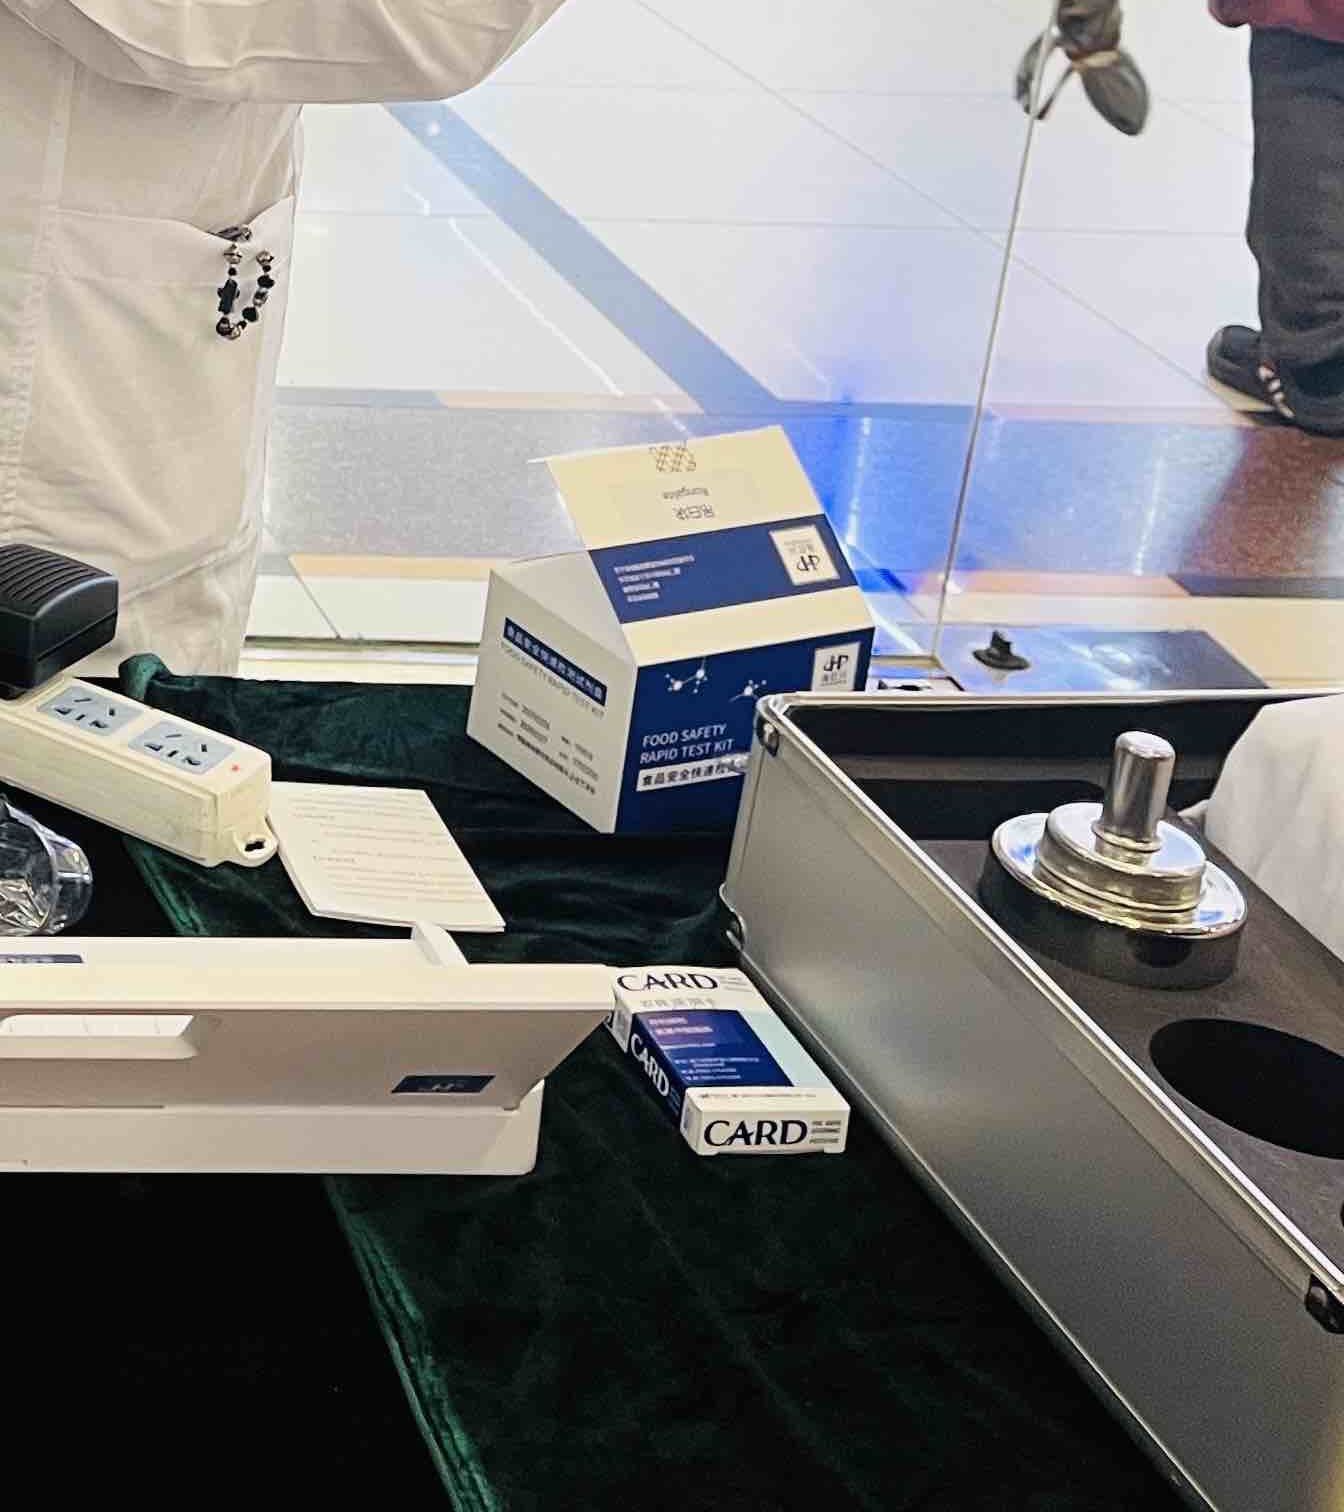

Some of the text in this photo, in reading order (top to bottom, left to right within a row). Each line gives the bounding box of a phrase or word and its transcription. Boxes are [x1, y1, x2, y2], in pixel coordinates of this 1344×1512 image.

[643, 723, 727, 748] FOOD SAFETY
[640, 738, 735, 764] RAPID TEST KIT
[617, 973, 718, 991] CARD
[631, 1033, 670, 1097] CARD
[704, 1119, 808, 1146] CARD
